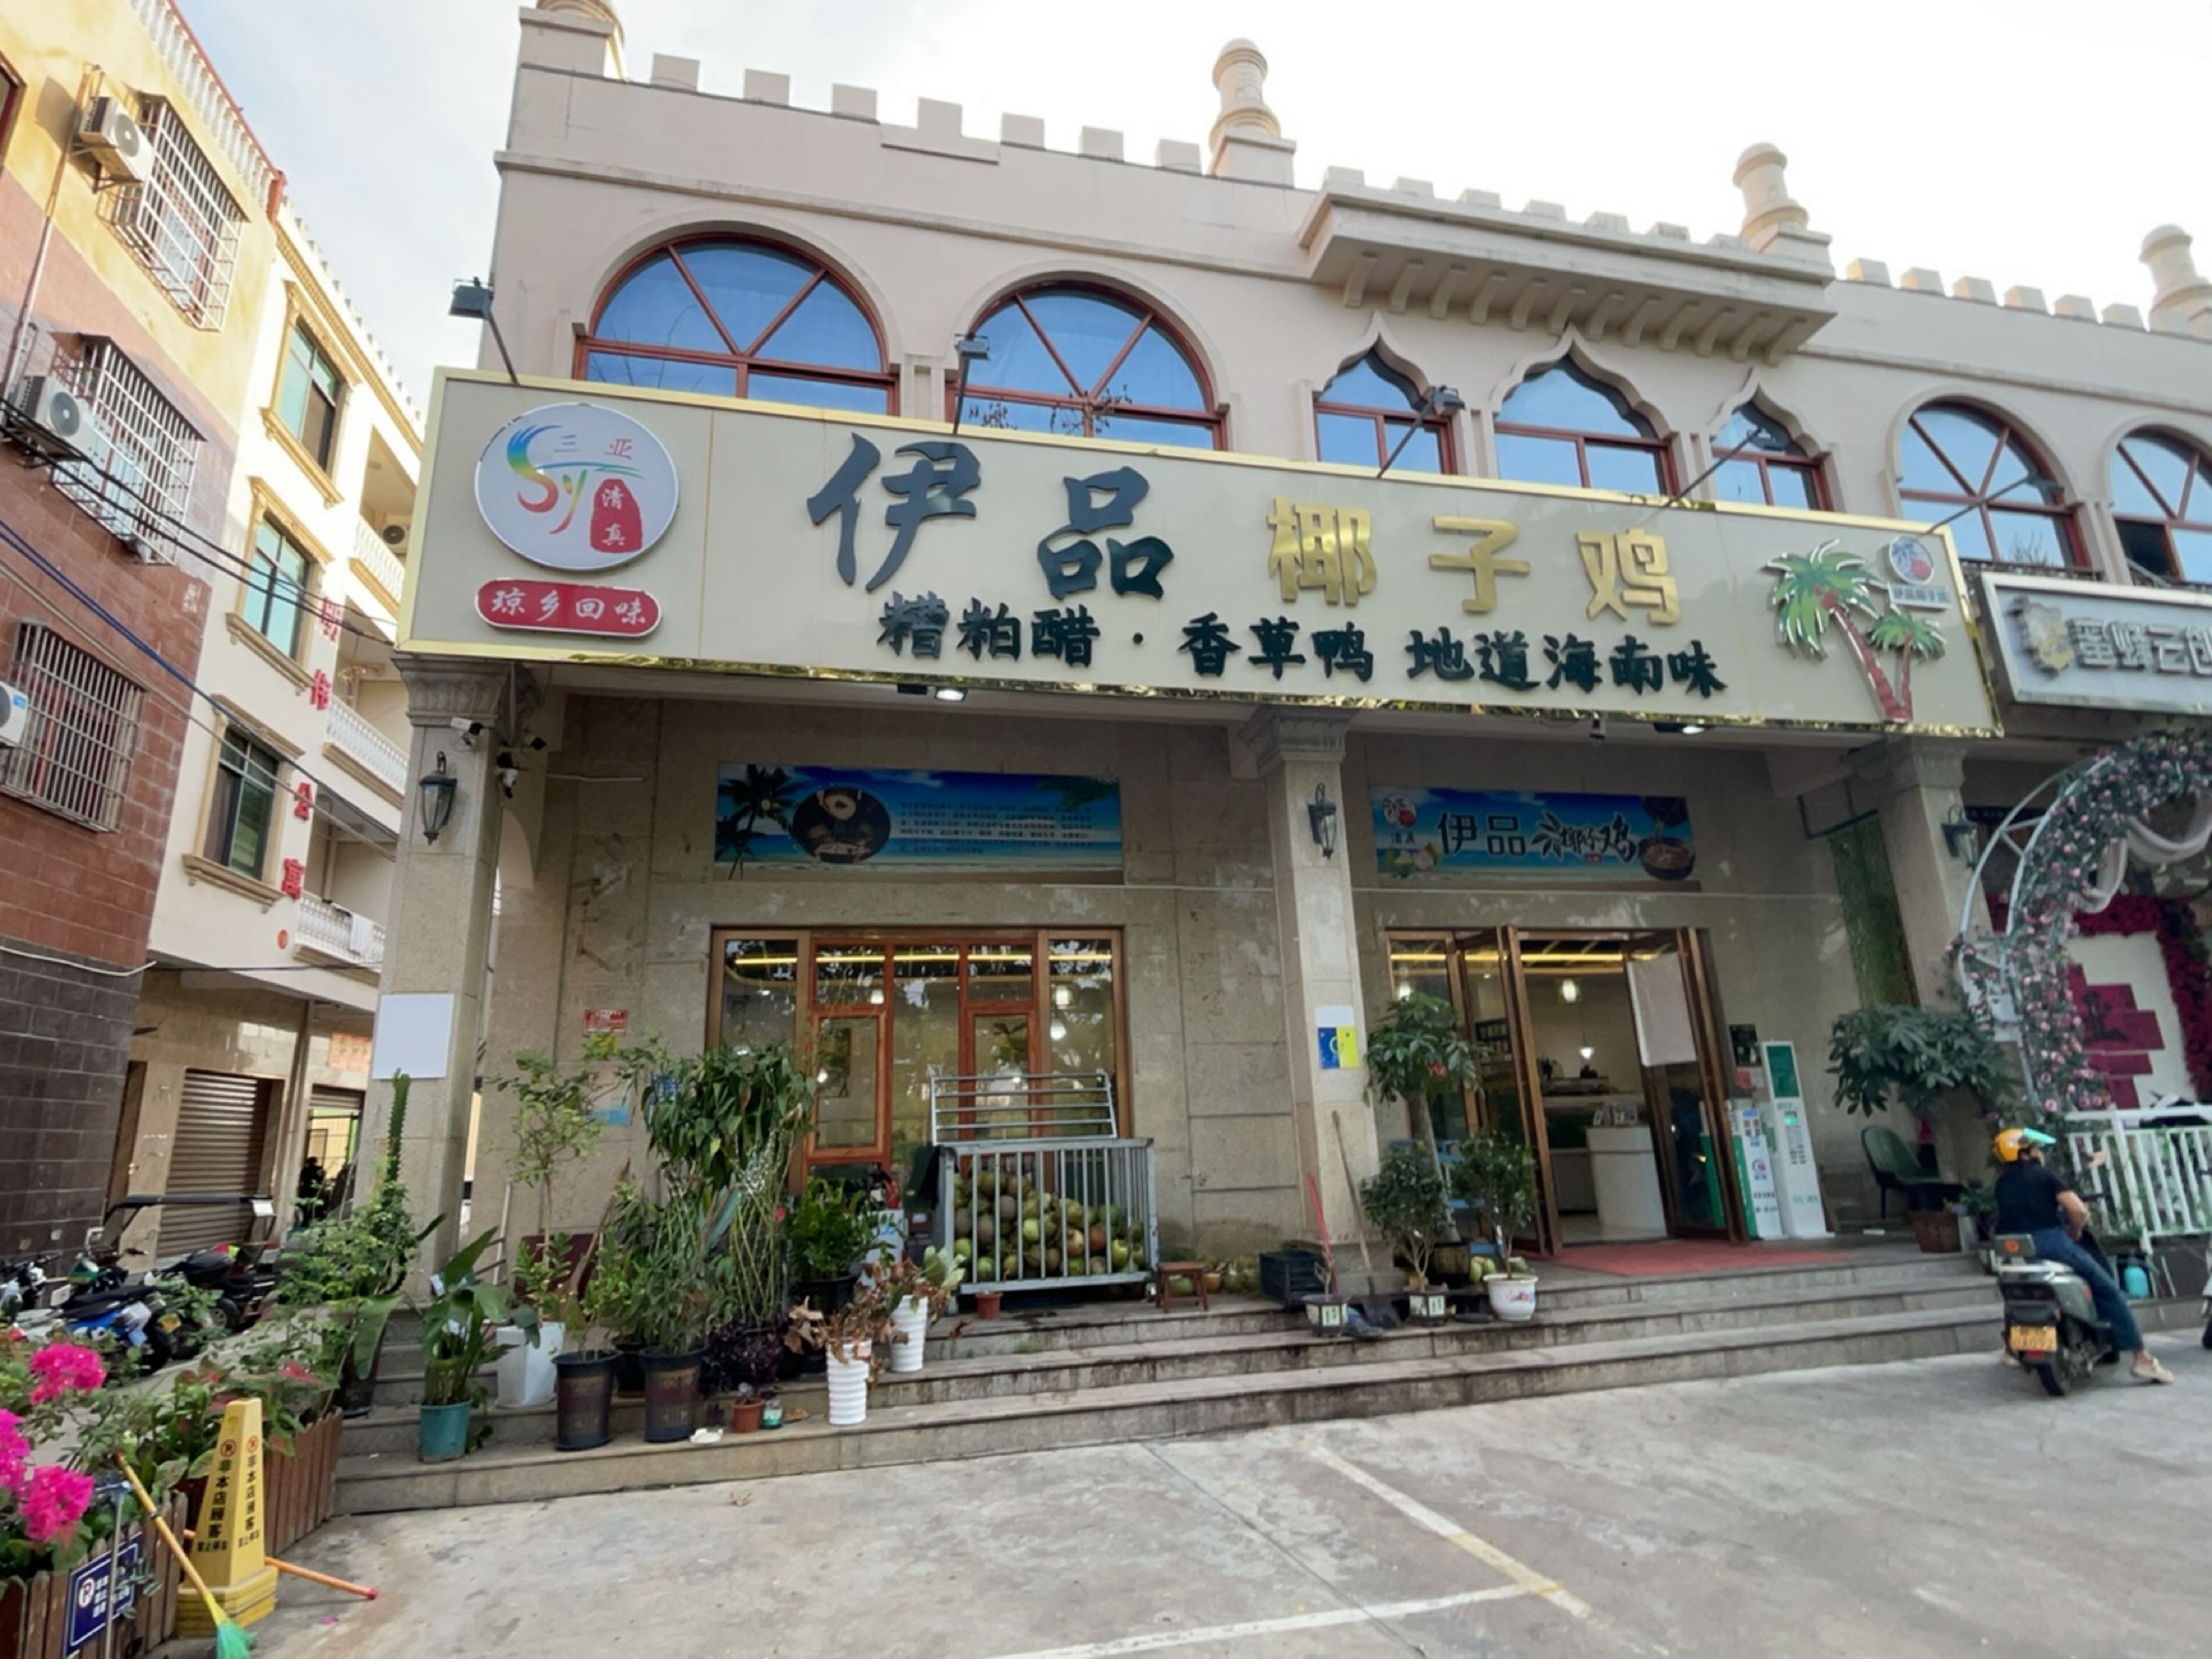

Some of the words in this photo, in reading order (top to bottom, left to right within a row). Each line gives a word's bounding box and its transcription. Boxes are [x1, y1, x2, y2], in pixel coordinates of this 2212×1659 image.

[552, 434, 633, 460] 三亚
[601, 485, 626, 546] 清真
[806, 433, 1174, 600] 伊品
[1265, 497, 1679, 627] 椰子鸡
[492, 589, 646, 626] 琼乡回味
[1405, 625, 1727, 698] 地道海南味
